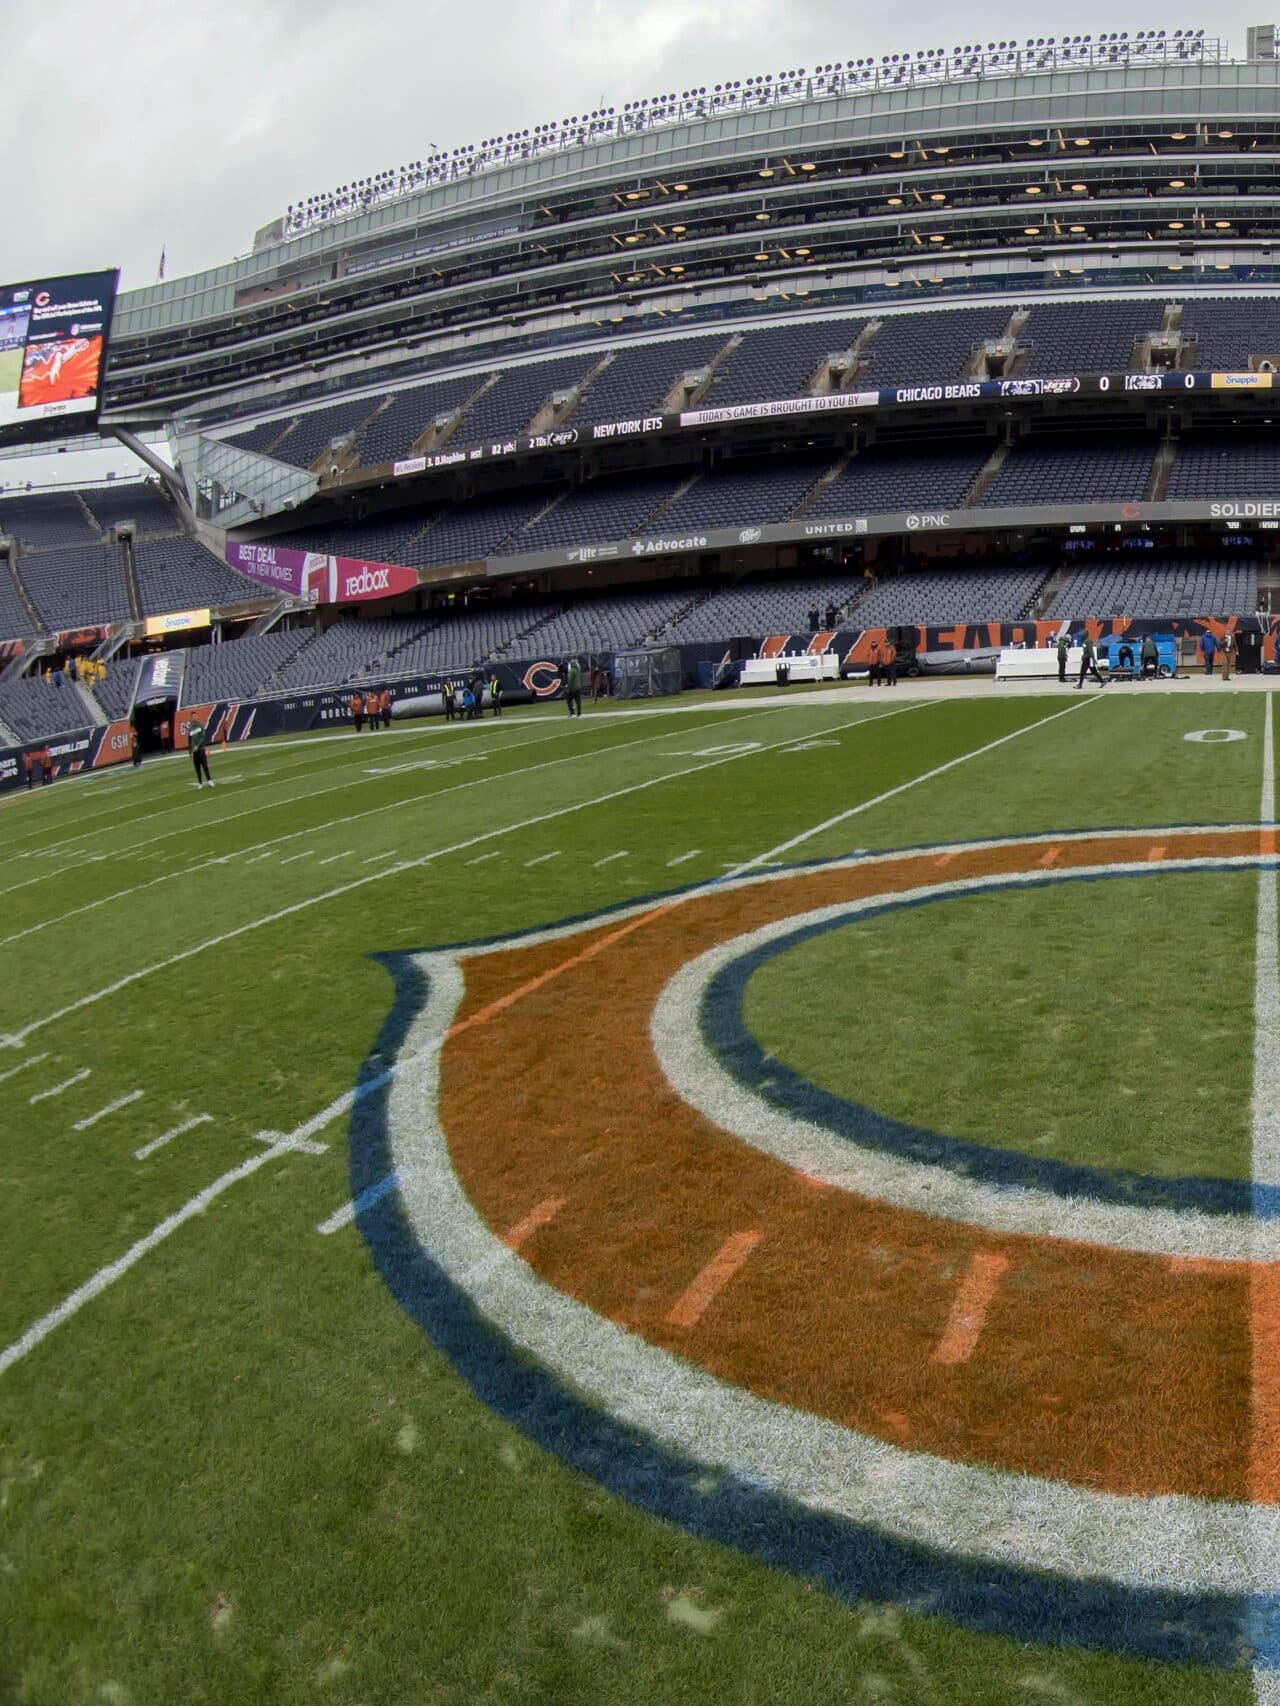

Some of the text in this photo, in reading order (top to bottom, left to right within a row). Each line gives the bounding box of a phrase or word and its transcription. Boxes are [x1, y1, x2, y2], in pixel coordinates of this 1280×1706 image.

[1099, 376, 1109, 391] 0
[1184, 374, 1195, 389] 0
[1226, 375, 1258, 386] Snapple
[896, 384, 981, 402] CHICAGO BEARS
[699, 395, 859, 423] TODAY'S GAME IS BROUGHT TO YOU BY
[593, 416, 664, 439] NEW YORK JETS
[922, 514, 950, 528] PNC
[805, 523, 853, 536] UNITED
[645, 535, 708, 553] Advocate
[239, 544, 276, 564] BEST DEAL
[247, 561, 257, 575] ON
[257, 563, 270, 577] NEW
[346, 566, 389, 597] redbox
[111, 734, 129, 749] GSH
